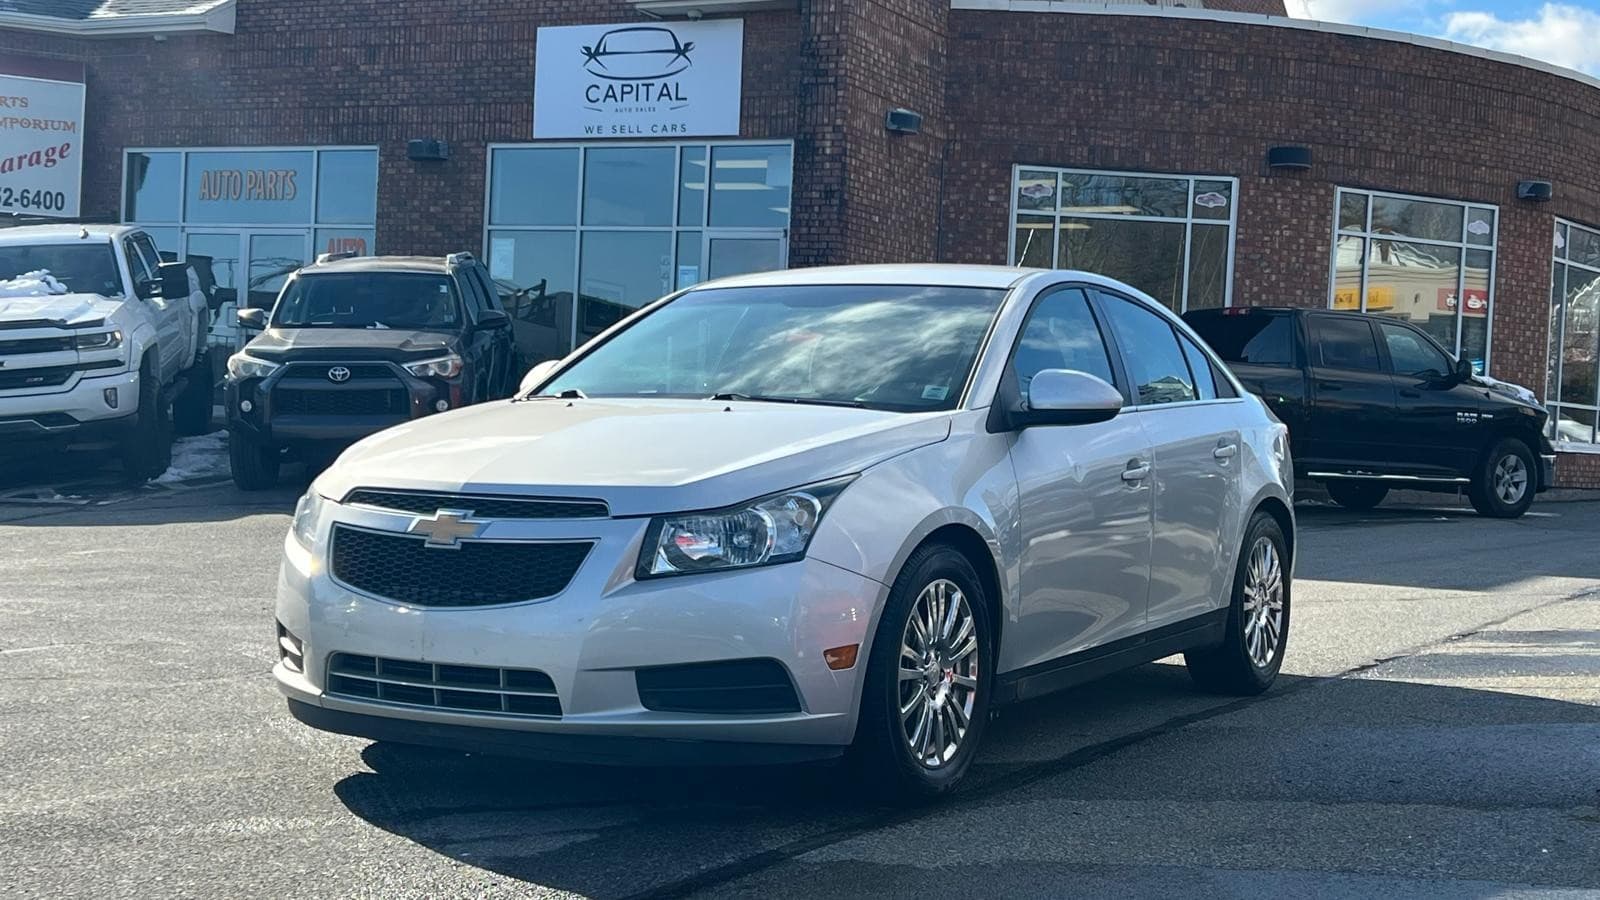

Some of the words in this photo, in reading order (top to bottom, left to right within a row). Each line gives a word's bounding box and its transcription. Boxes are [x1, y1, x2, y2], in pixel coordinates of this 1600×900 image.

[585, 82, 688, 103] CAPITAL
[584, 125, 604, 135] WE
[611, 124, 643, 134] SELL
[651, 123, 688, 134] CARS
[200, 169, 243, 201] AUTO
[245, 169, 298, 201] PARTS
[0, 187, 66, 212] 2-6400
